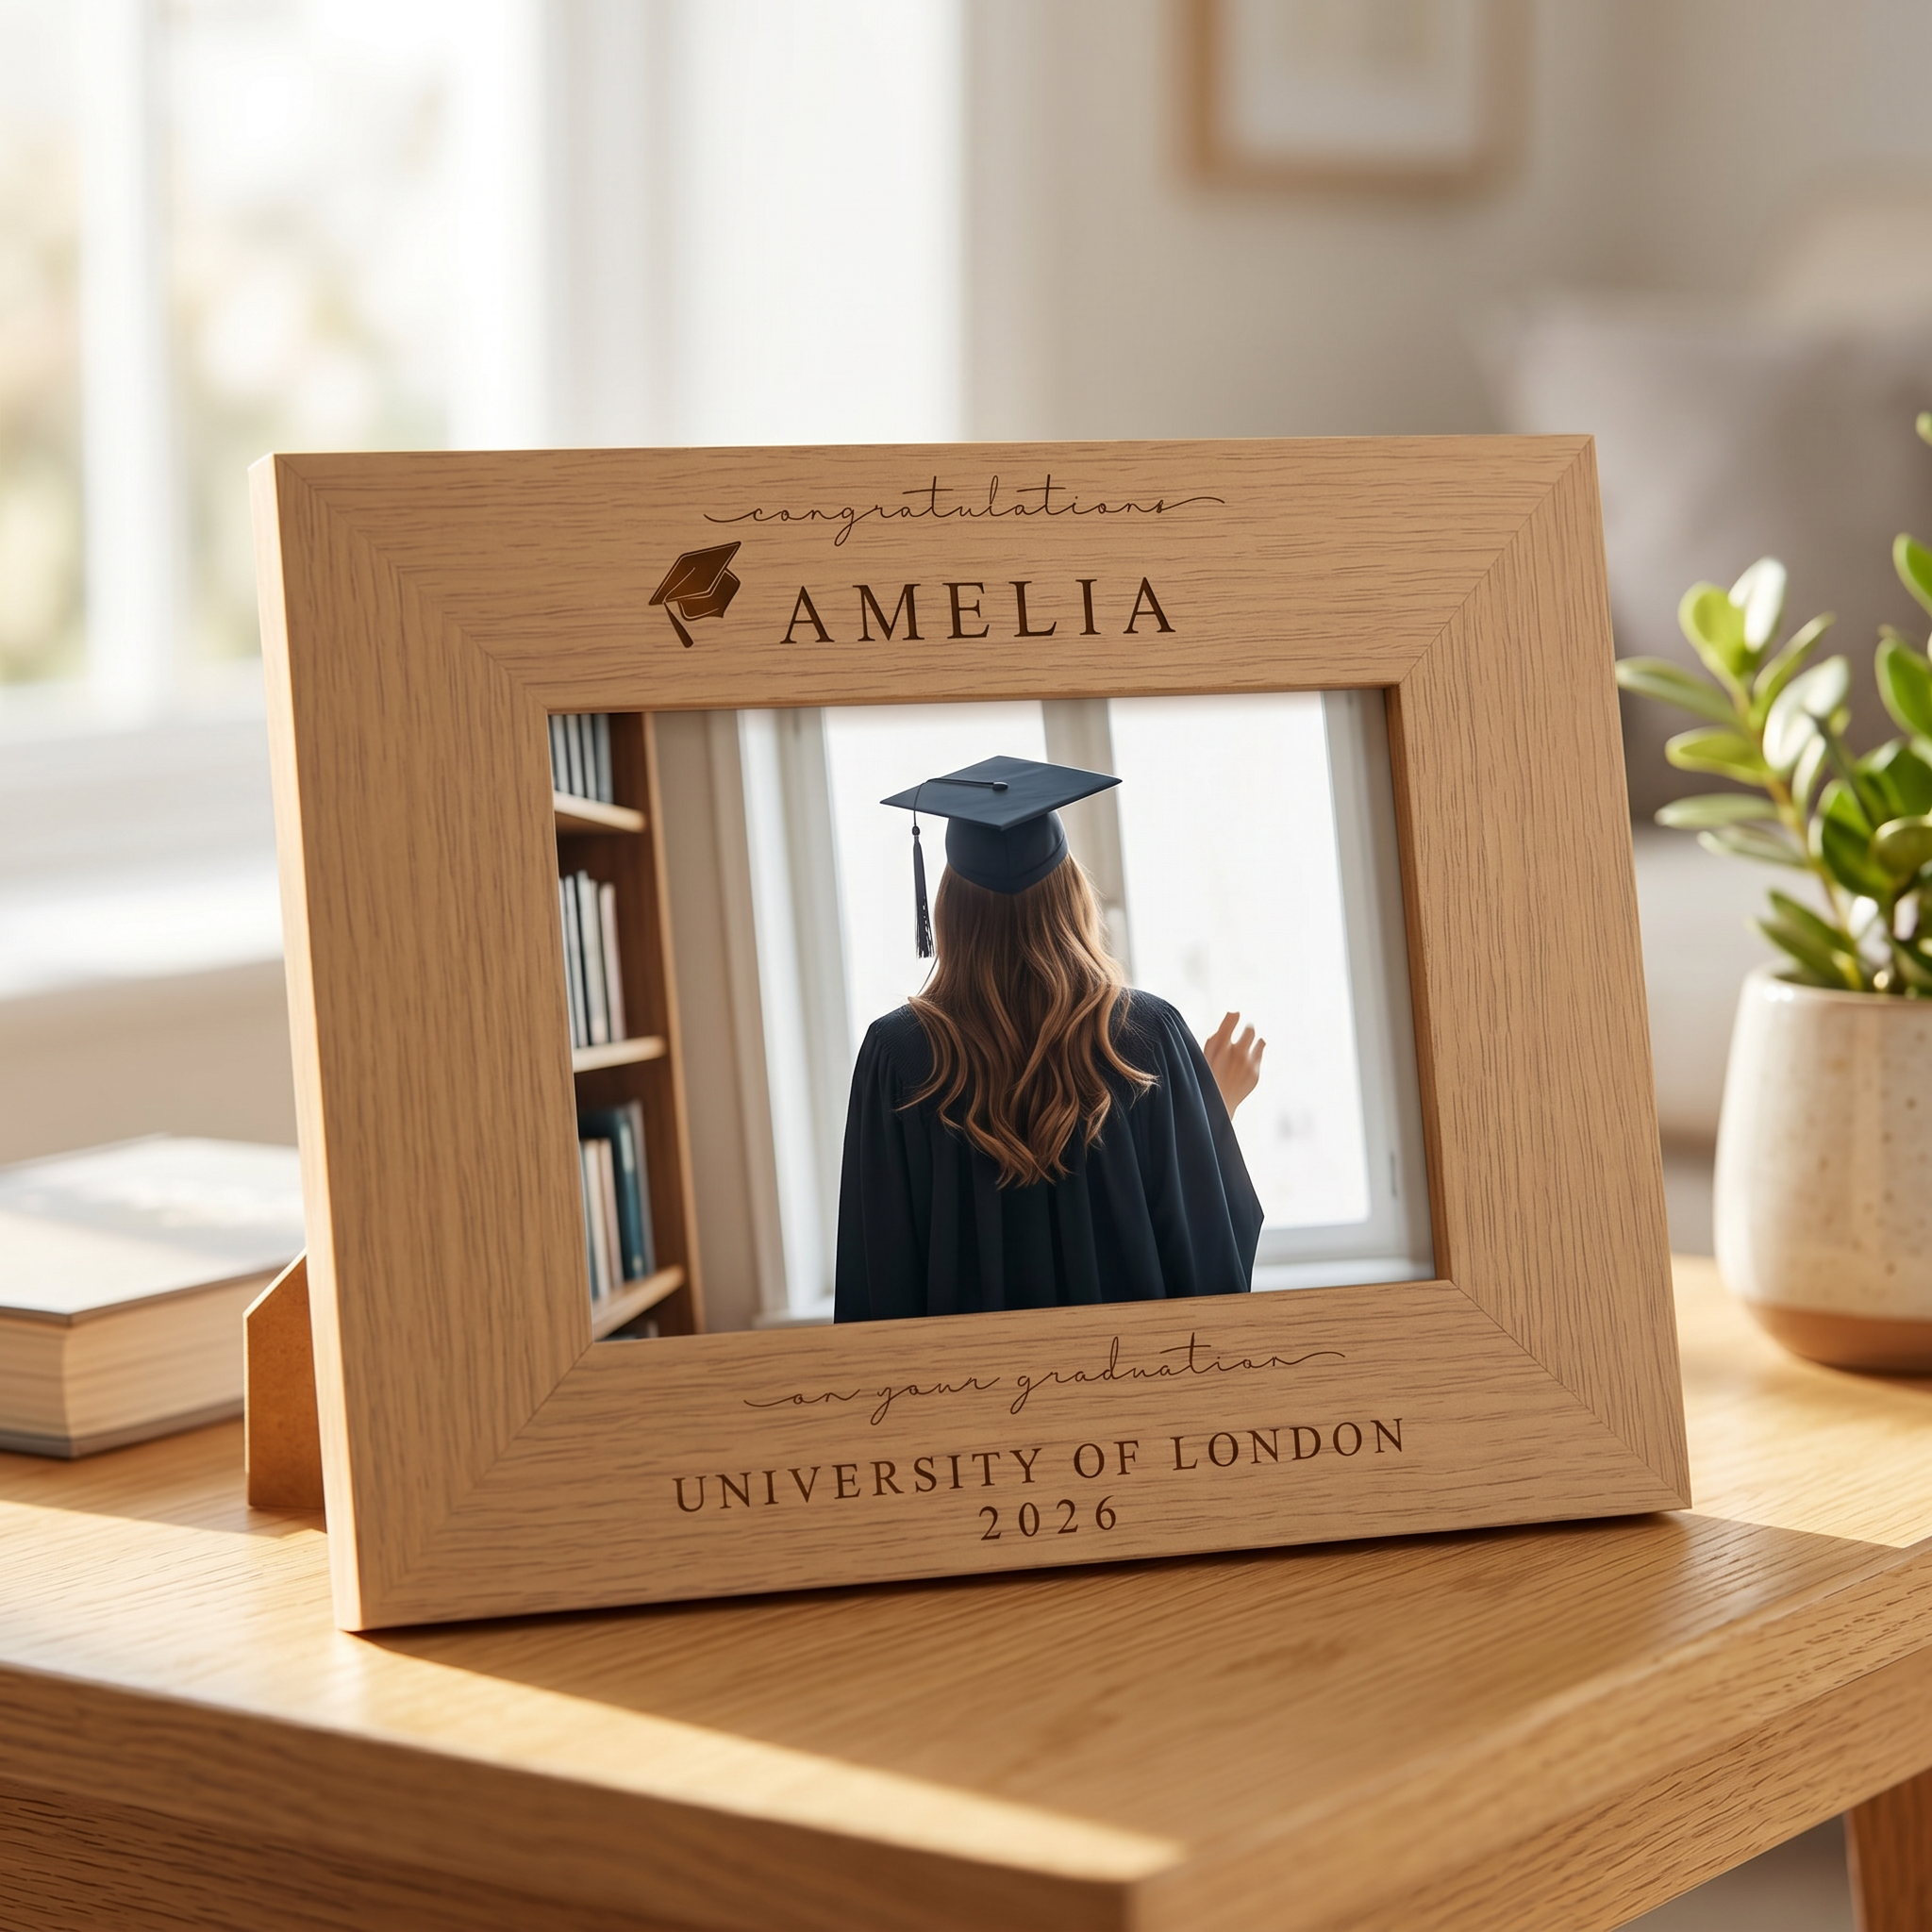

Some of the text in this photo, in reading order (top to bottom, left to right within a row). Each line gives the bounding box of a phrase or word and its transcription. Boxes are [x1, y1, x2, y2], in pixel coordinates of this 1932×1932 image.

[703, 474, 1225, 547] congratulations
[780, 576, 1177, 644] AMELIA
[743, 1331, 1346, 1426] on your graduation
[672, 1417, 1405, 1513] UNIVERSITY OF LONDON
[978, 1493, 1118, 1541] 2026
